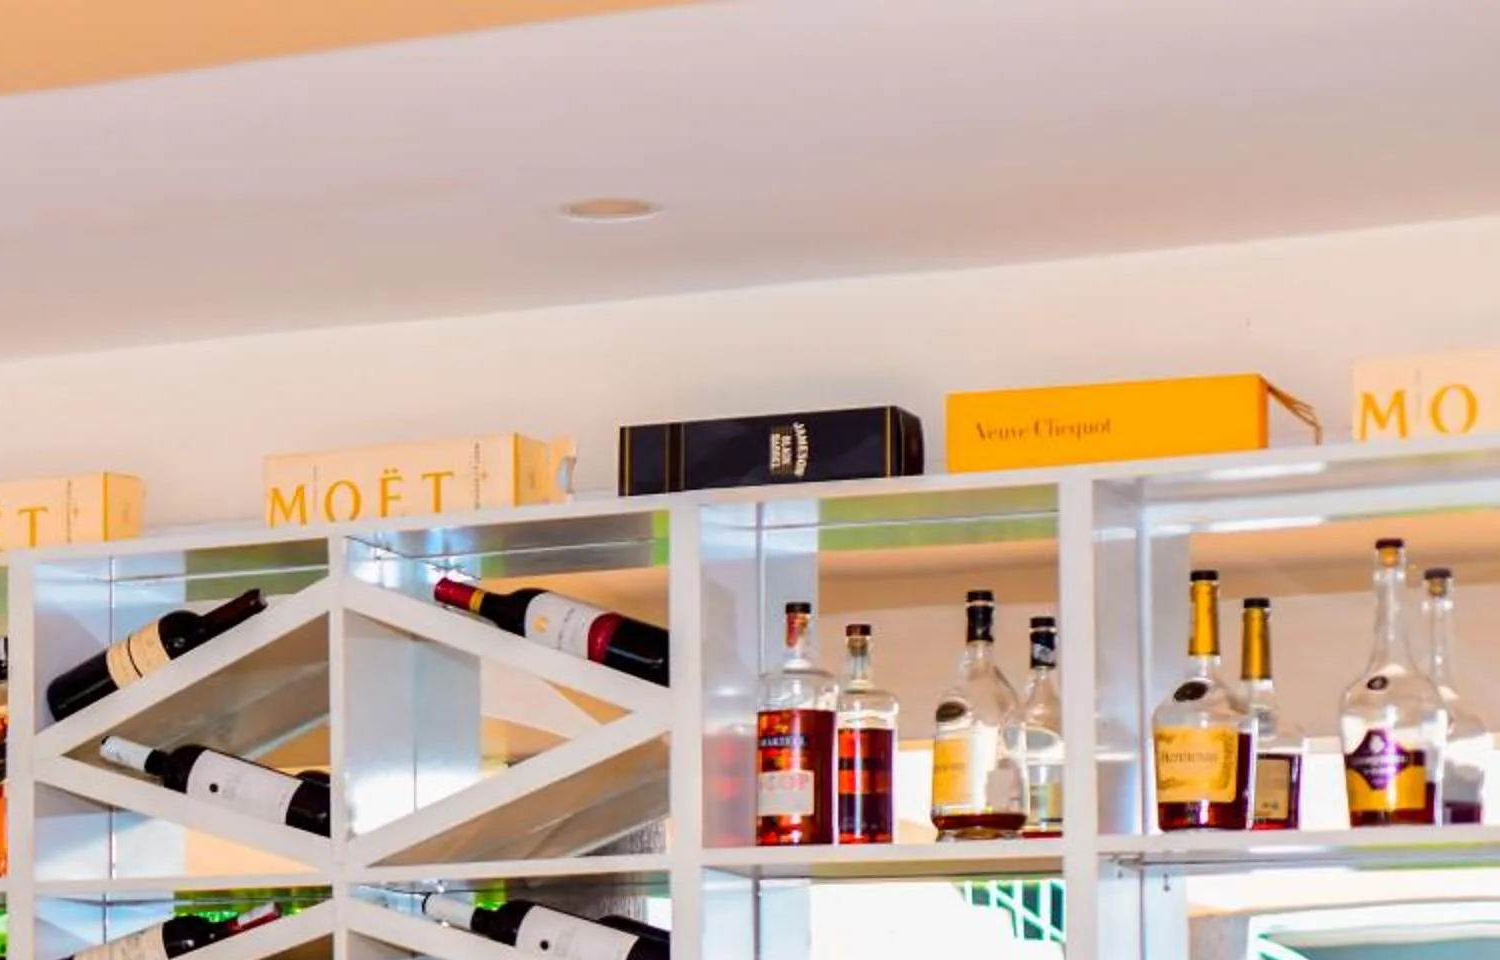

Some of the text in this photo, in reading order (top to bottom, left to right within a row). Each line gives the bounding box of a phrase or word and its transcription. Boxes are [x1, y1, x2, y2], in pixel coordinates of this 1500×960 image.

[976, 417, 1112, 441] Veuve Clicquot
[267, 467, 454, 528] MOËT
